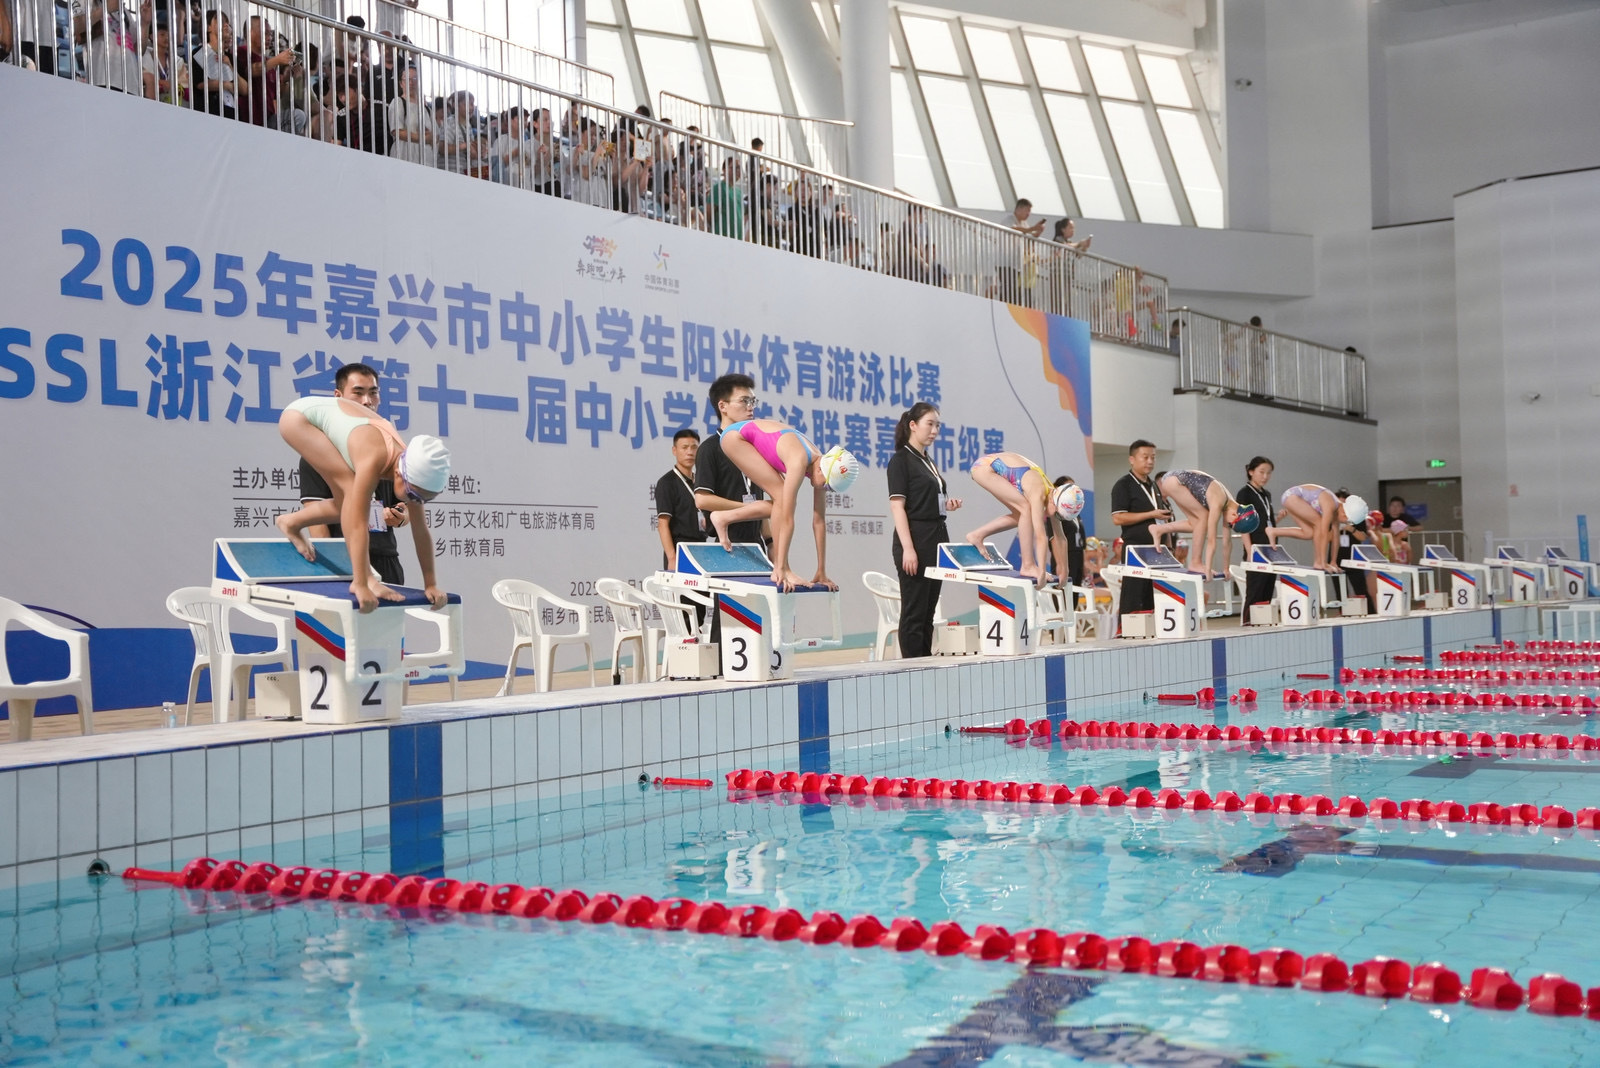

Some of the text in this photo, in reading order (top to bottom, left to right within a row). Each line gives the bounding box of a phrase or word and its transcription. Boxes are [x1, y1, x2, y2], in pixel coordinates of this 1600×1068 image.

[60, 228, 942, 409] 2025年嘉兴市中小学生阳光体育游泳比赛
[443, 474, 481, 494] 单位:
[435, 537, 505, 558] 乡市教育局
[683, 578, 699, 587] anti
[943, 571, 957, 580] anti
[222, 585, 239, 598] anti
[1457, 588, 1469, 606] 8
[1568, 580, 1579, 596] 0
[1287, 599, 1302, 620] 6
[1383, 593, 1395, 611] 7
[1163, 608, 1177, 632] 5
[1190, 607, 1197, 632] 5
[985, 619, 1004, 648] 4
[1020, 618, 1030, 646] 4
[731, 636, 749, 672] 3
[309, 664, 330, 711] 2
[361, 660, 383, 707] 2
